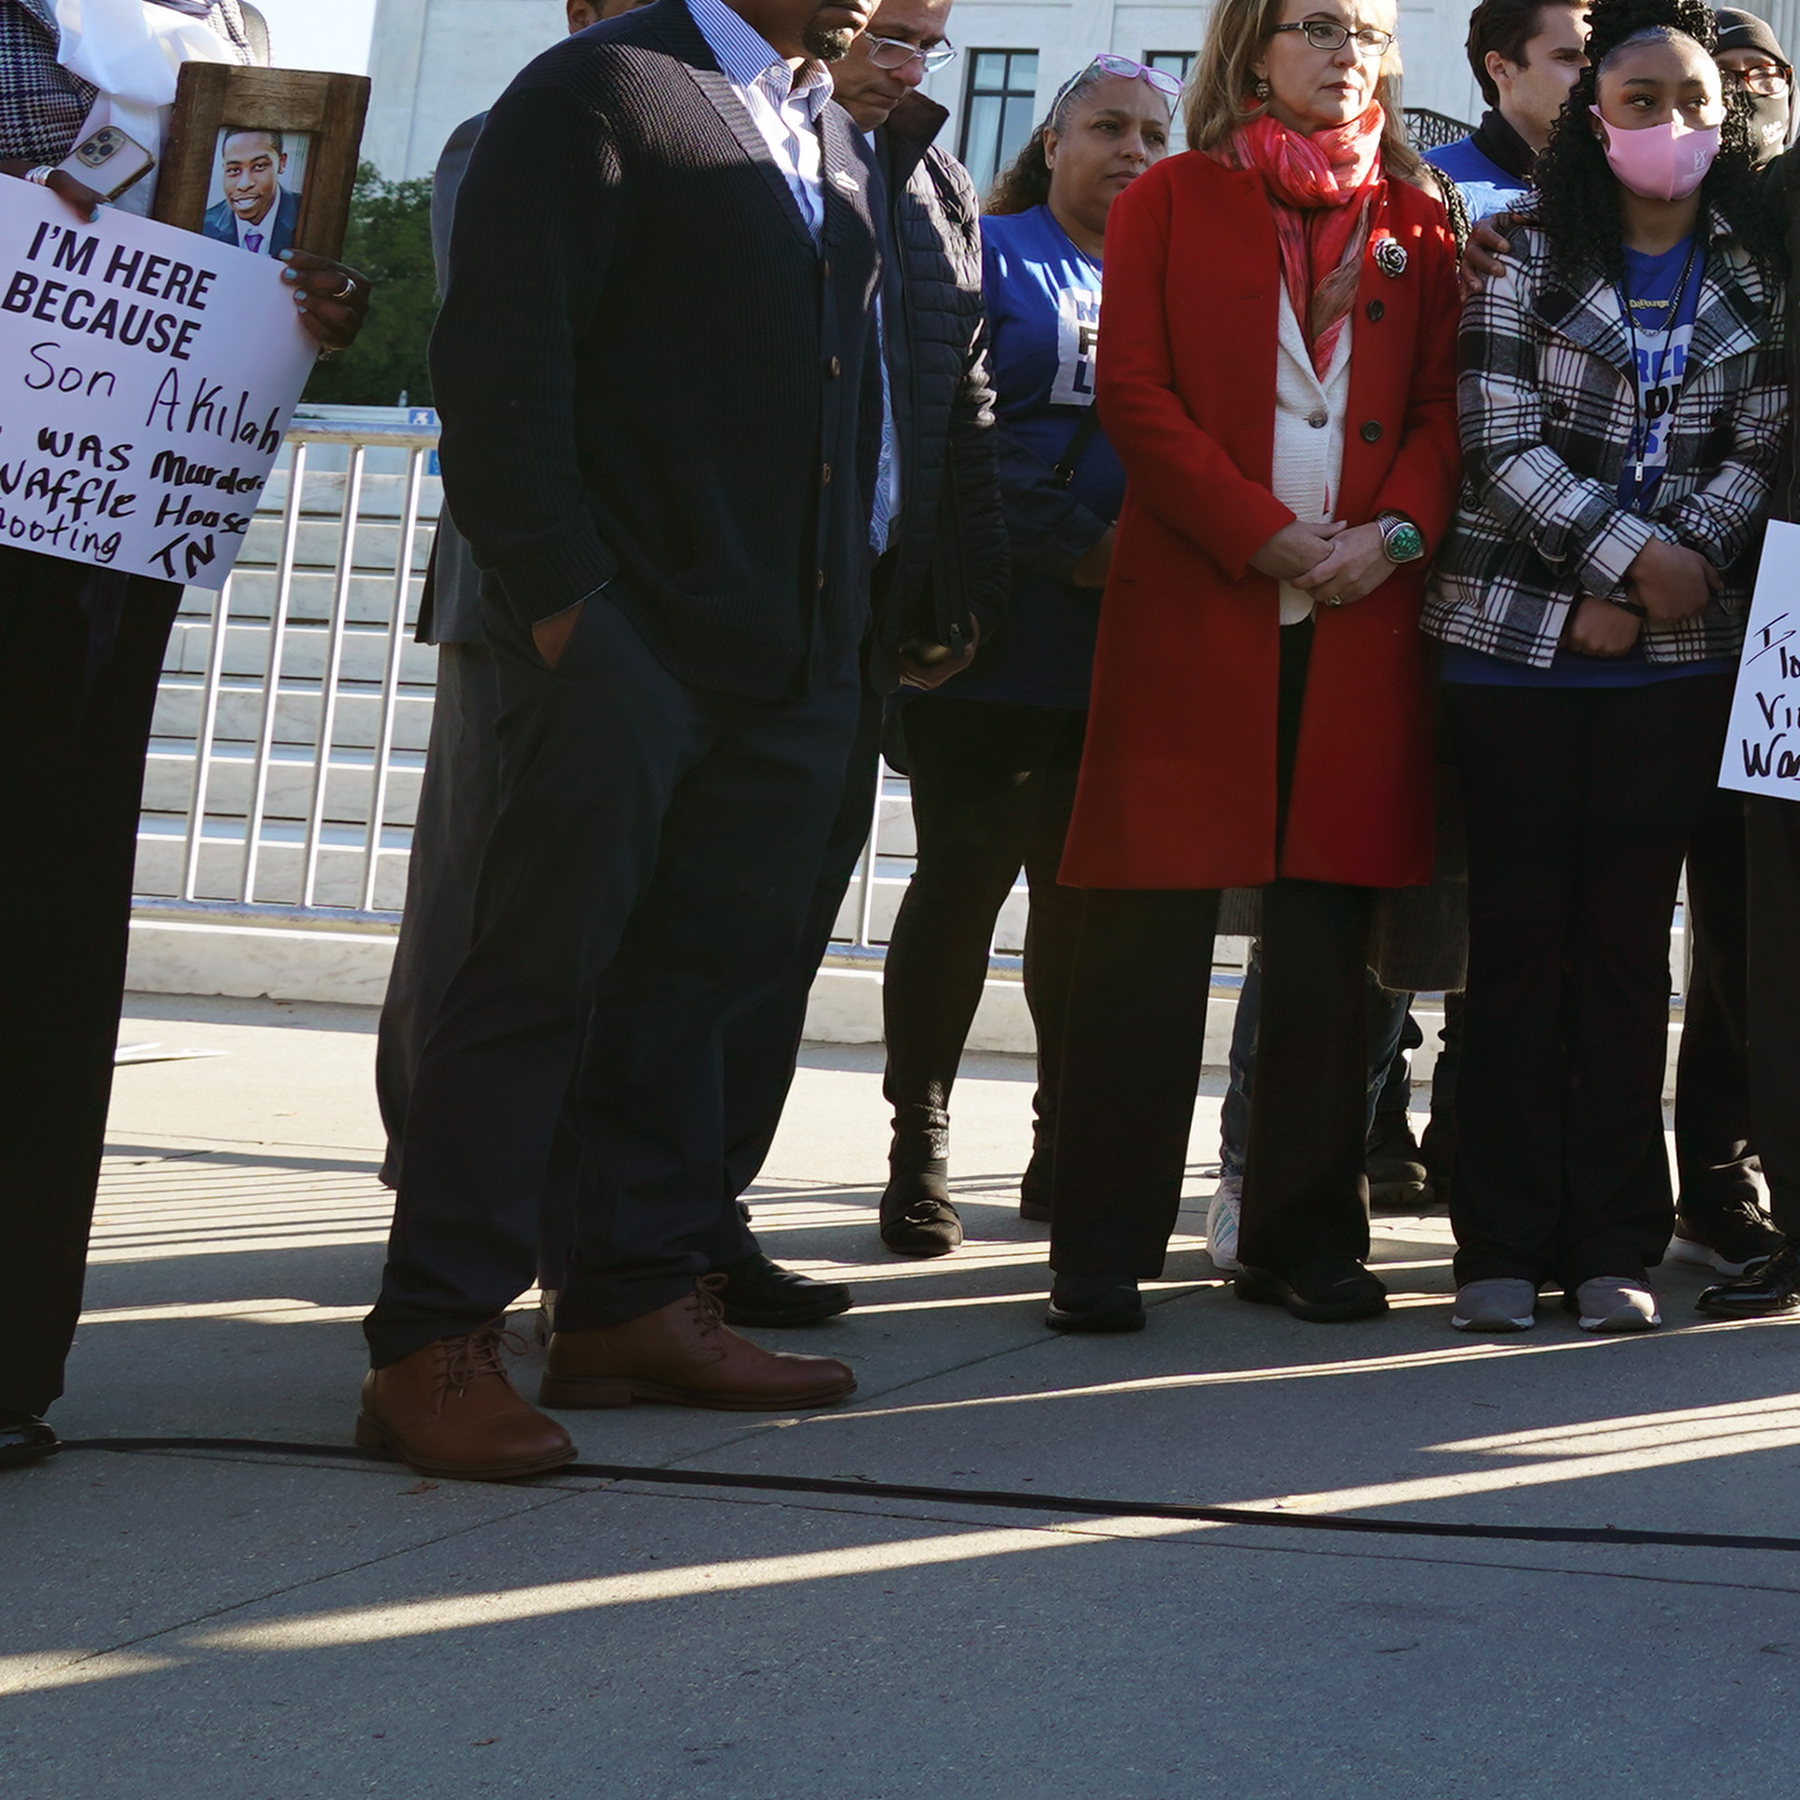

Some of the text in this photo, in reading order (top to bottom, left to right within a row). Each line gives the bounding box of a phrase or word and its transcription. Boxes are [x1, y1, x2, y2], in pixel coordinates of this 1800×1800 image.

[27, 222, 218, 310] I'M HERE
[1, 271, 201, 361] BECAUSE
[25, 342, 116, 397] Son
[148, 532, 216, 579] TN
